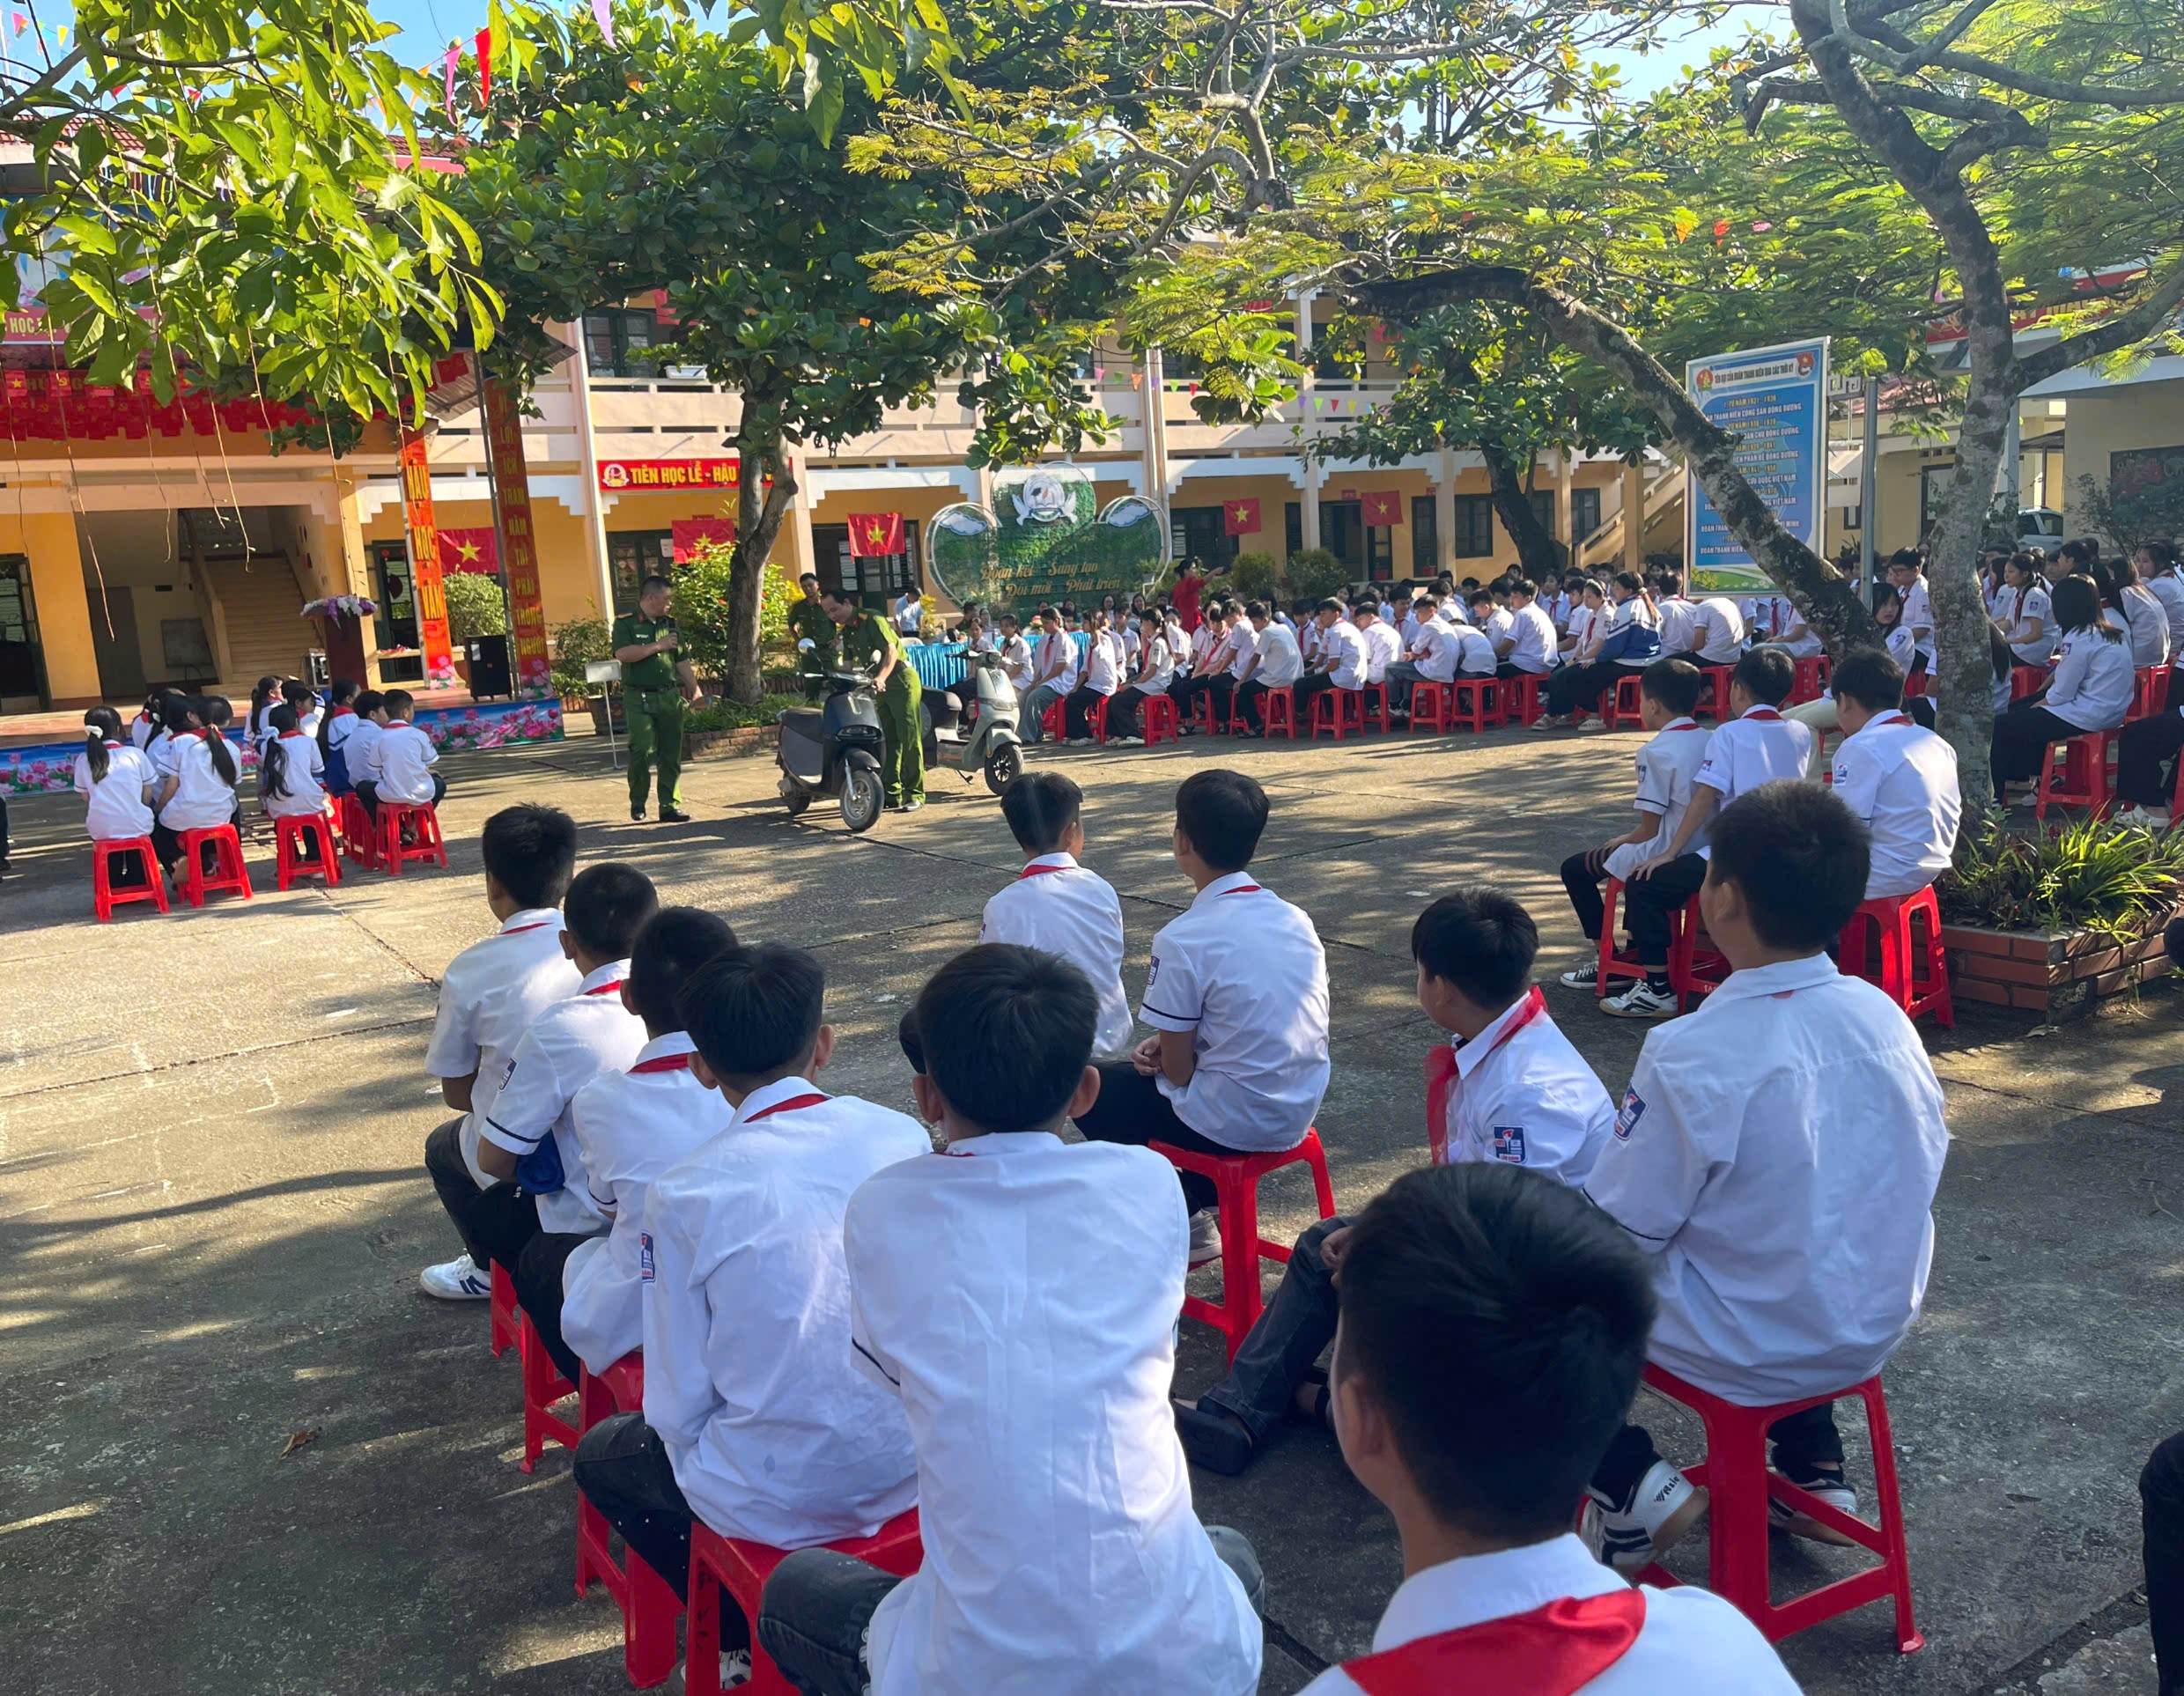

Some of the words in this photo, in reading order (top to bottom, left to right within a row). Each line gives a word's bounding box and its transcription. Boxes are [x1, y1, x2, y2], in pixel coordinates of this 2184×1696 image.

[10, 317, 35, 337] HỌC
[1714, 412, 1729, 421] THANH
[1730, 409, 1741, 419] NIÊN
[1742, 408, 1755, 417] CỘNG
[1768, 404, 1782, 414] ĐÔNG
[630, 464, 659, 484] TIÊN
[661, 466, 686, 486] HỌC
[688, 461, 703, 483] LỄ
[712, 463, 737, 485] HẬU
[414, 526, 436, 568] HỌC
[422, 578, 445, 620] VĂN
